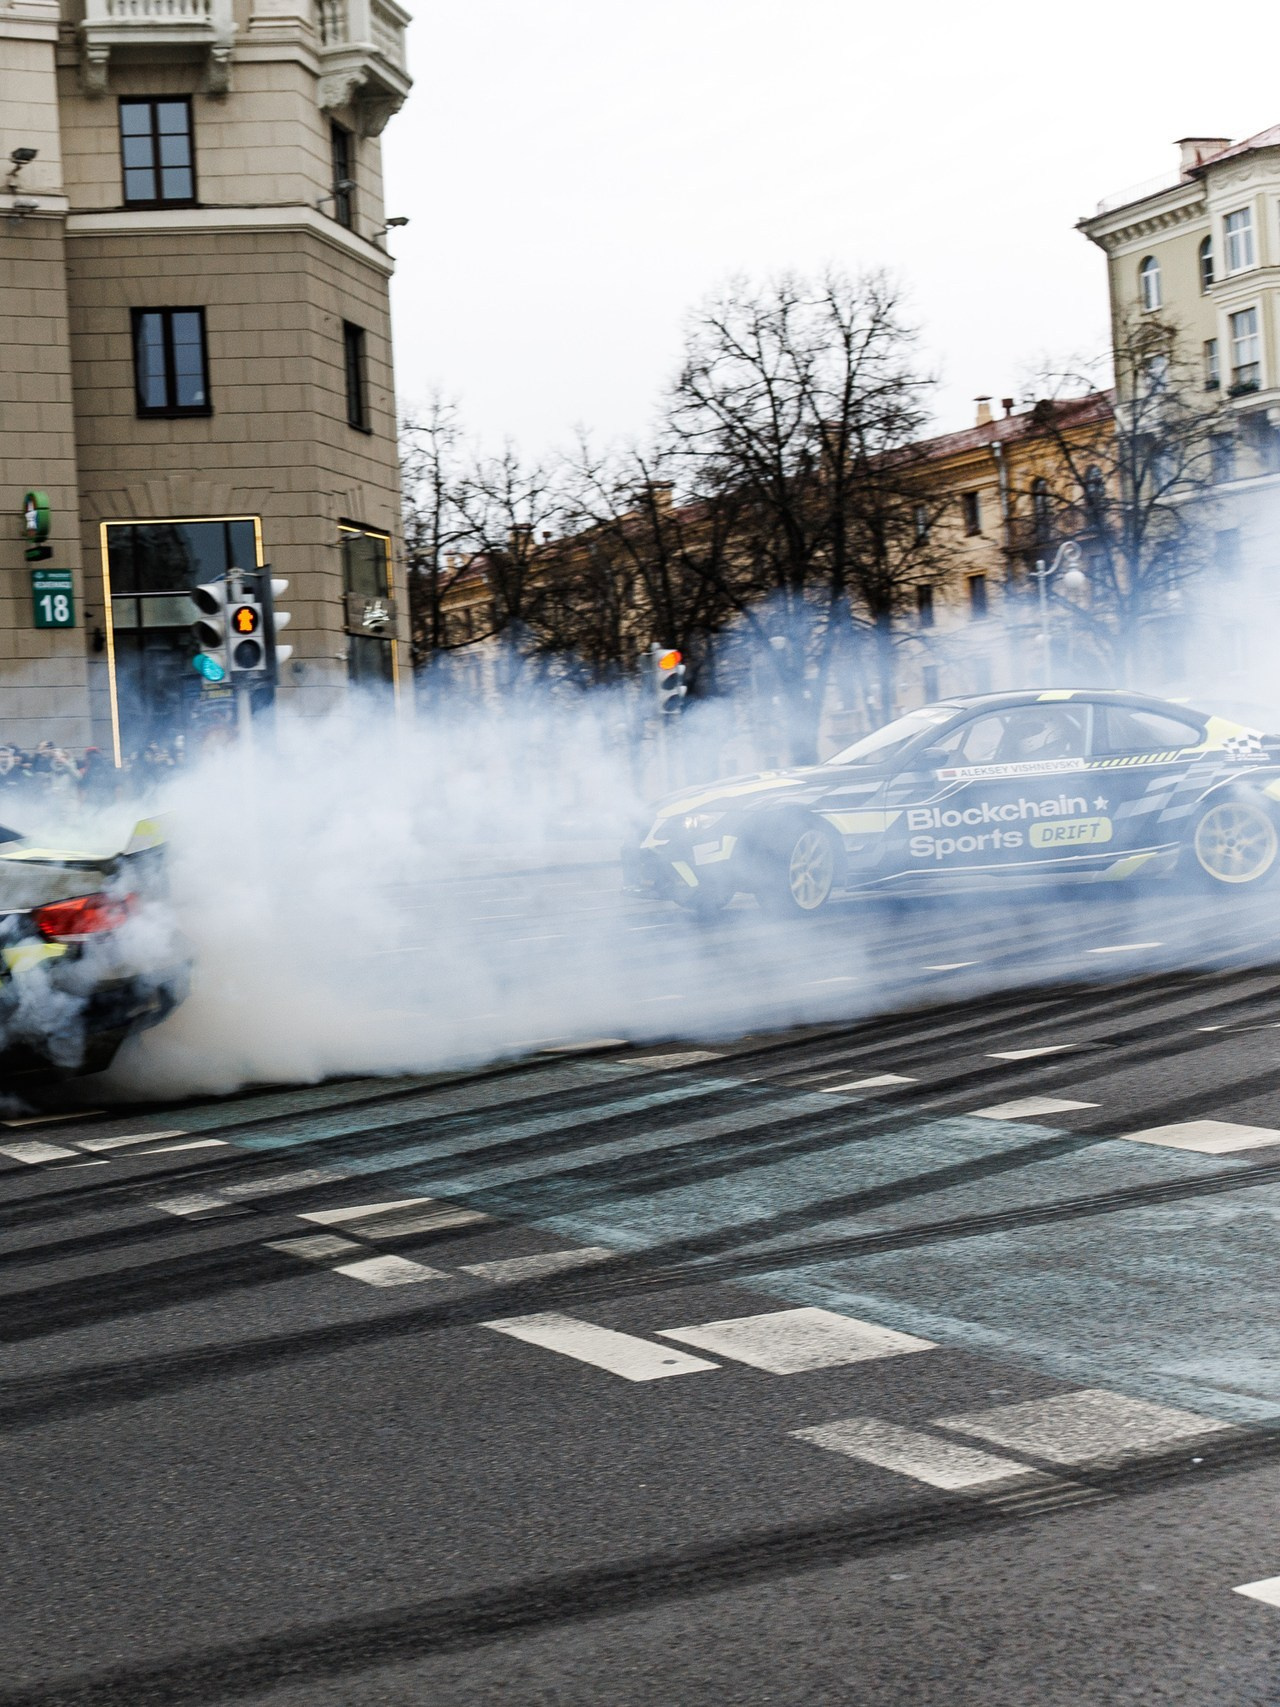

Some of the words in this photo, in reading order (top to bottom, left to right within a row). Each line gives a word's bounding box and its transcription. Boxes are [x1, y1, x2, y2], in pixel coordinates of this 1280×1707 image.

[40, 595, 69, 622] 18
[960, 765, 1008, 777] ALEKSEY
[1011, 760, 1080, 773] VISHNEVSKY
[907, 794, 1087, 831] Blockchain
[909, 828, 1023, 859] Sports
[1041, 823, 1100, 842] DRIFT
